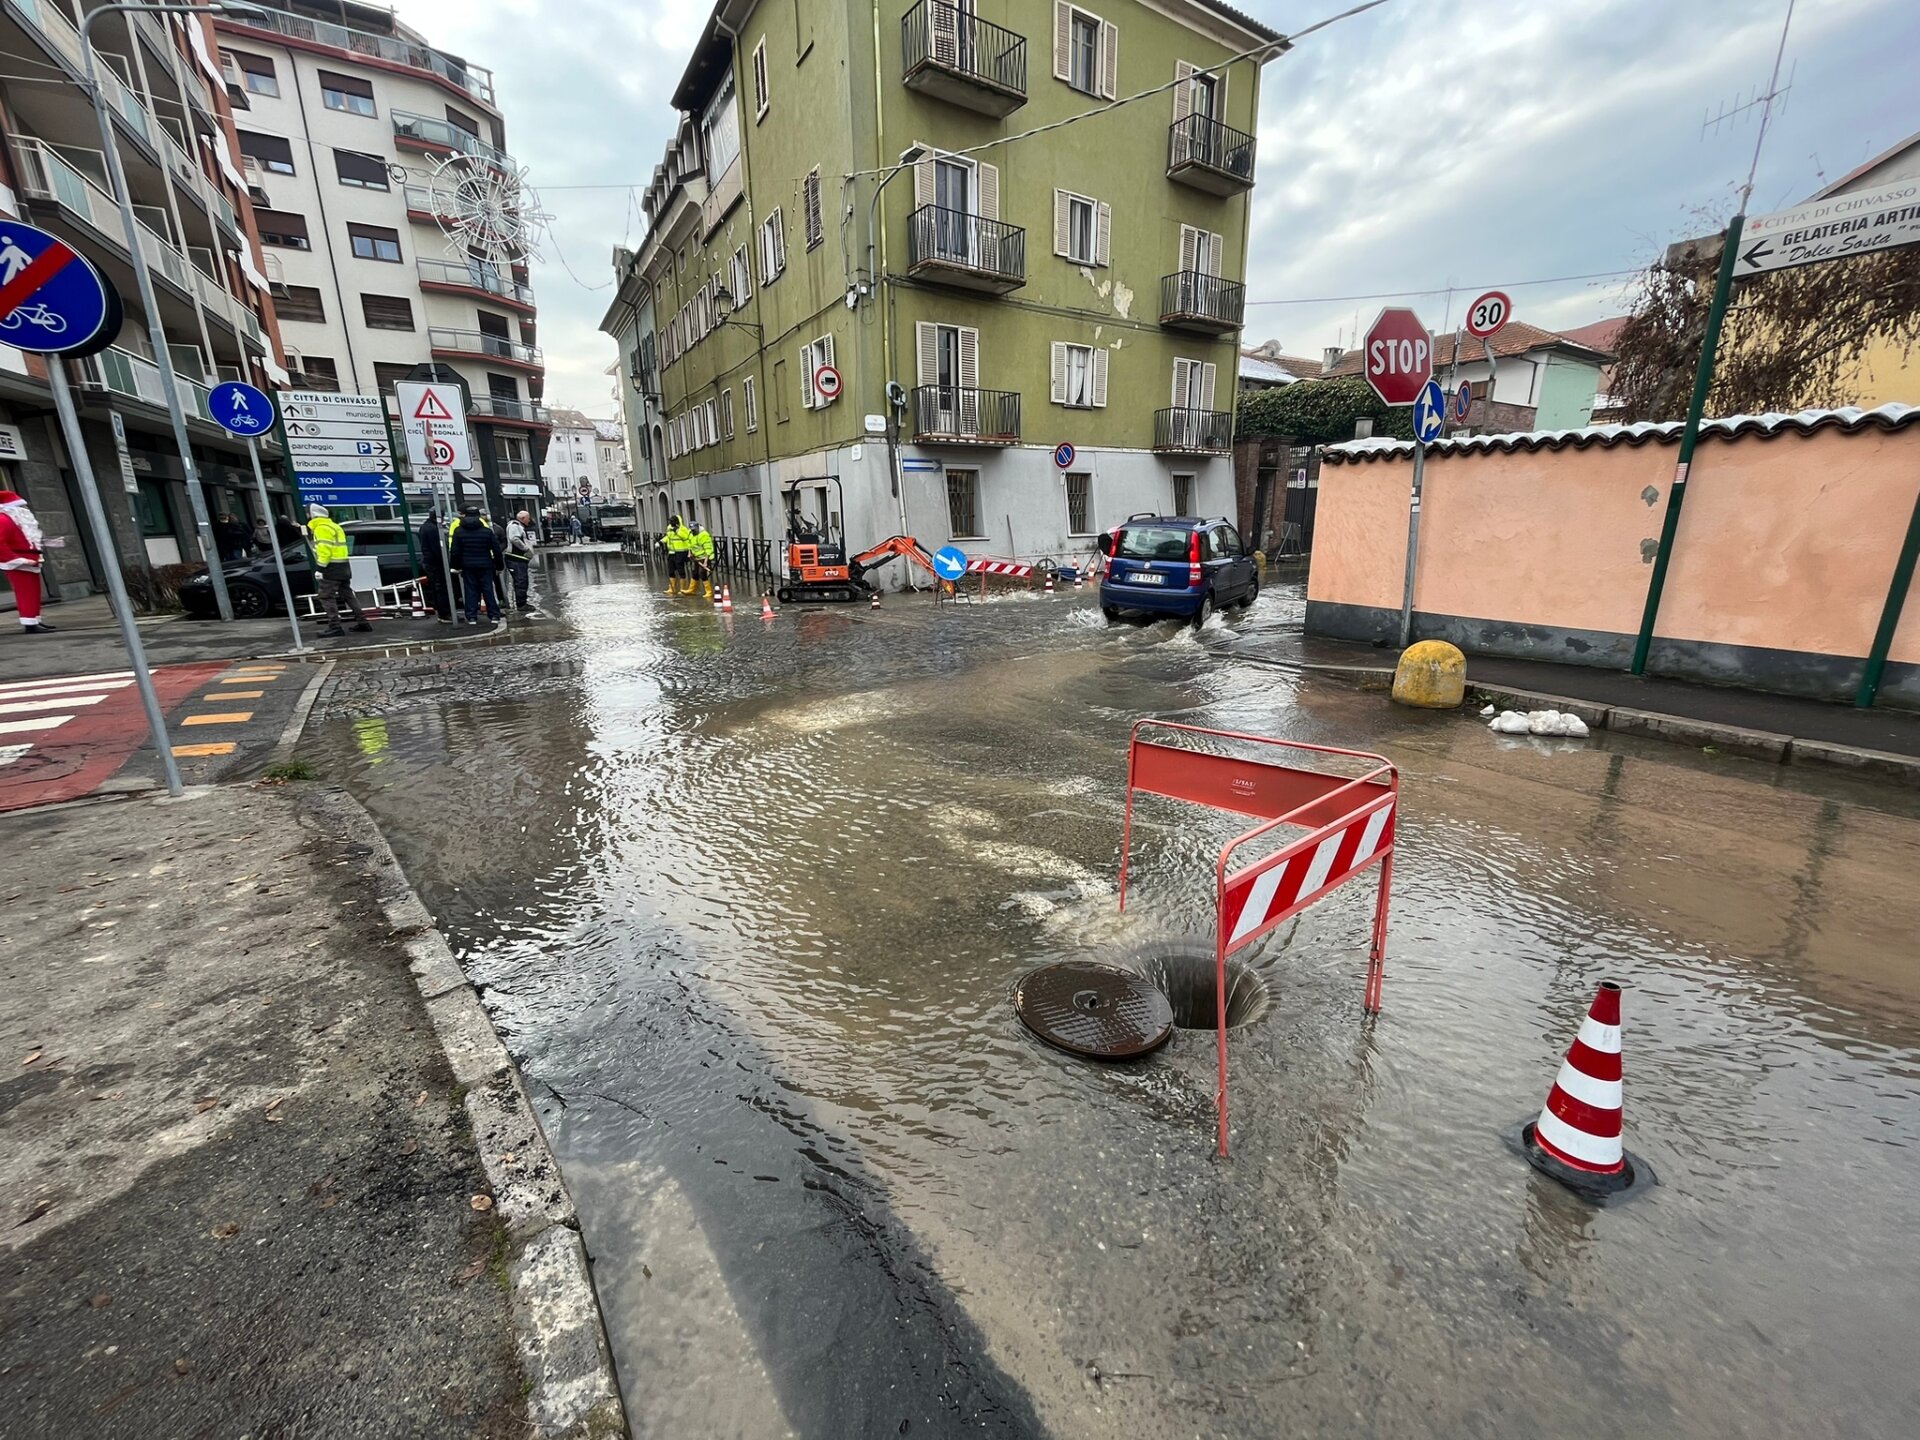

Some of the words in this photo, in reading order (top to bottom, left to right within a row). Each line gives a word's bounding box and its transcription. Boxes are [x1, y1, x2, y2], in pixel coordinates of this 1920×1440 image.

[1814, 205, 1831, 218] DI
[1834, 187, 1917, 213] CHIVASSO
[1782, 216, 1868, 246] GELATERIA
[1474, 302, 1502, 328] 30
[1370, 339, 1428, 375] STOP
[322, 395, 332, 403] DI
[334, 396, 378, 405] CHIVASSO
[345, 410, 381, 419] municipio
[361, 428, 385, 436] centro
[0, 436, 15, 449] RE
[291, 442, 334, 451] parcheggio
[296, 460, 329, 468] tribunale
[299, 477, 334, 485] TORINO
[304, 494, 323, 502] ASTI
